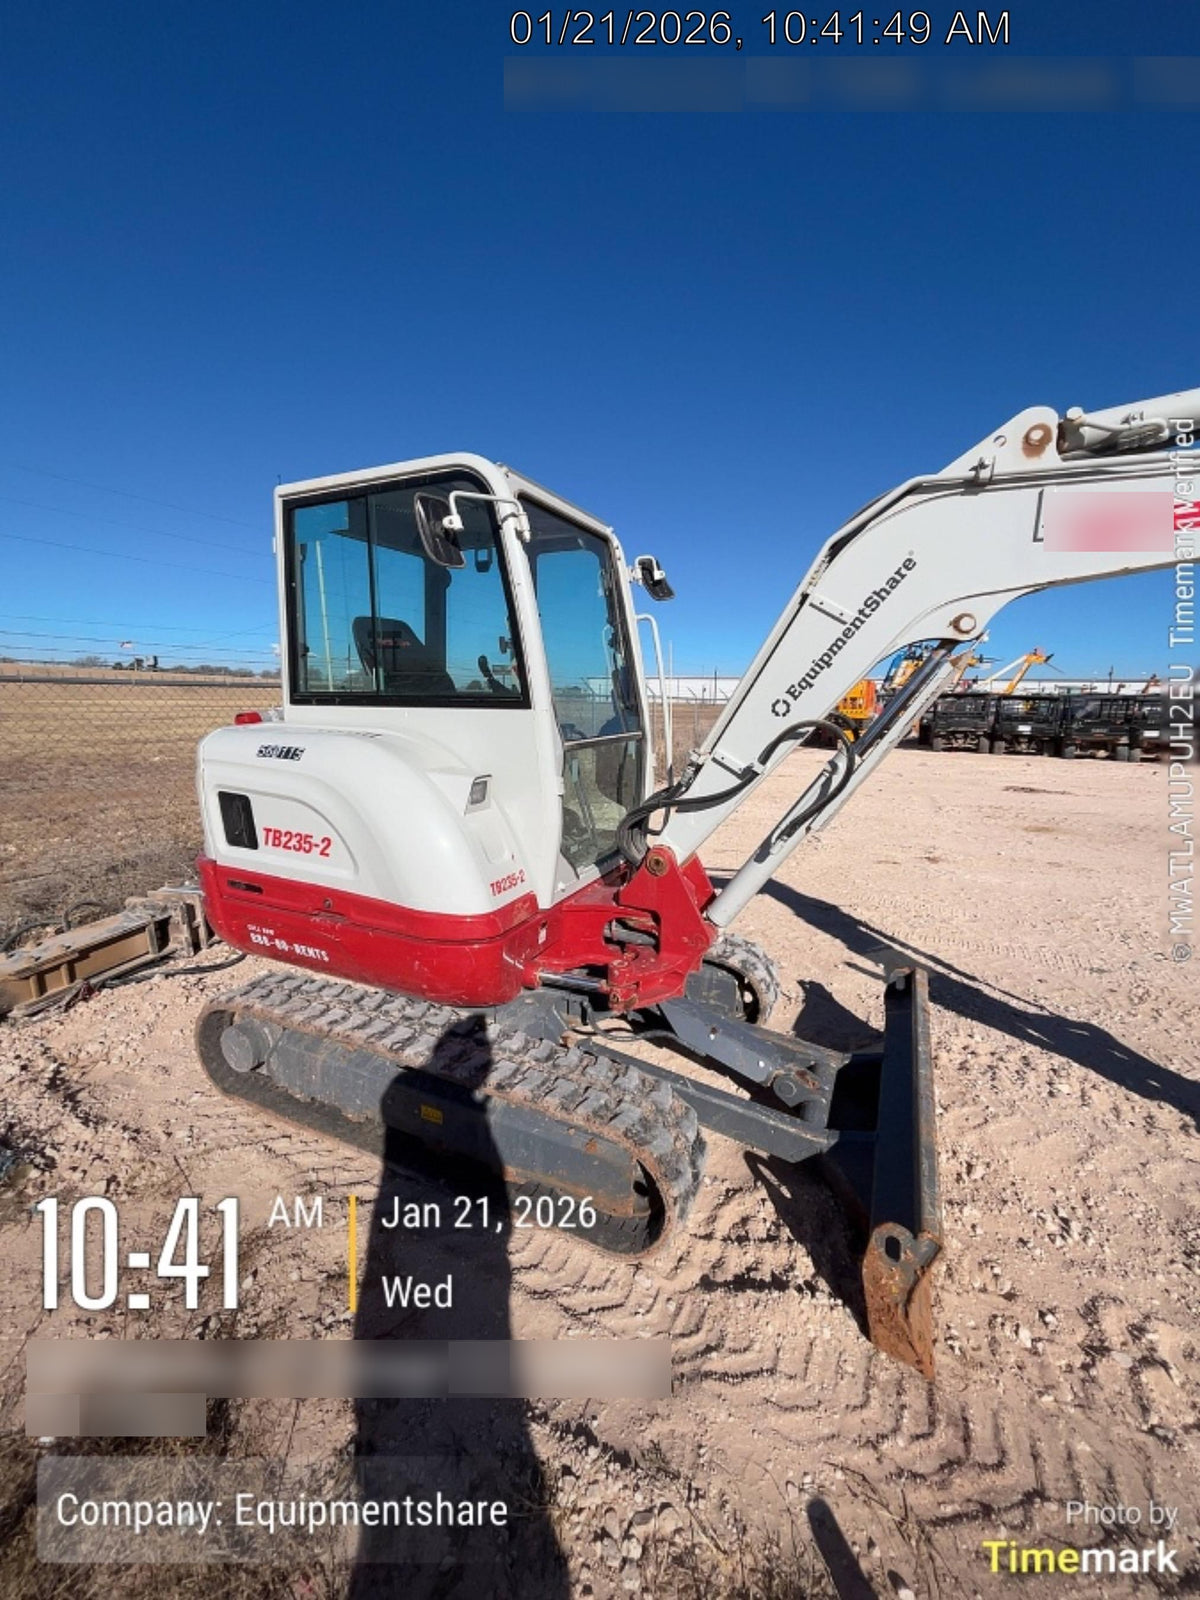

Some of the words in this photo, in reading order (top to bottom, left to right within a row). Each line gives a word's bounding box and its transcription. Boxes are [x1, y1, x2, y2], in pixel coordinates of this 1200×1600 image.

[785, 556, 917, 702] EquipmentShare
[262, 826, 333, 858] TB235-2
[489, 868, 526, 897] TB235-2
